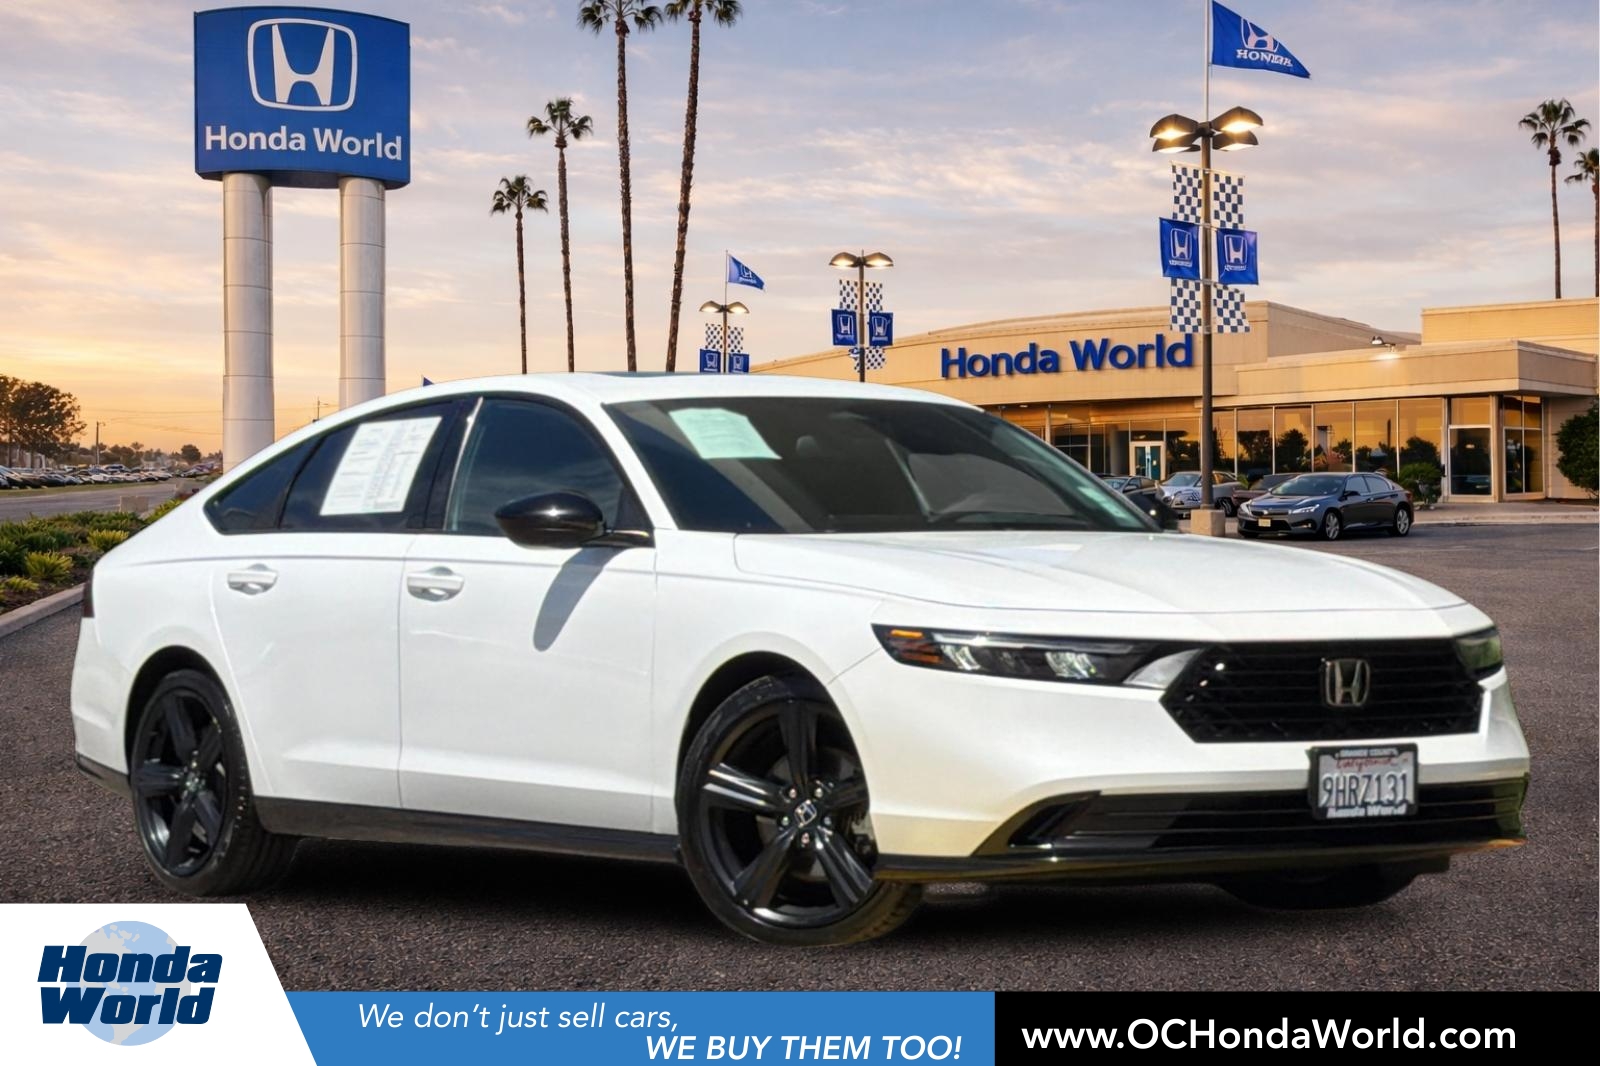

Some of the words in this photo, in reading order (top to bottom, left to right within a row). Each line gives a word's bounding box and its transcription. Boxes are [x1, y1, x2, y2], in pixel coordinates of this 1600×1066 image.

[205, 125, 306, 151] Honda
[313, 127, 402, 161] World
[941, 342, 1060, 379] Honda
[1070, 333, 1194, 371] World
[1321, 772, 1407, 807] 9HRZ131
